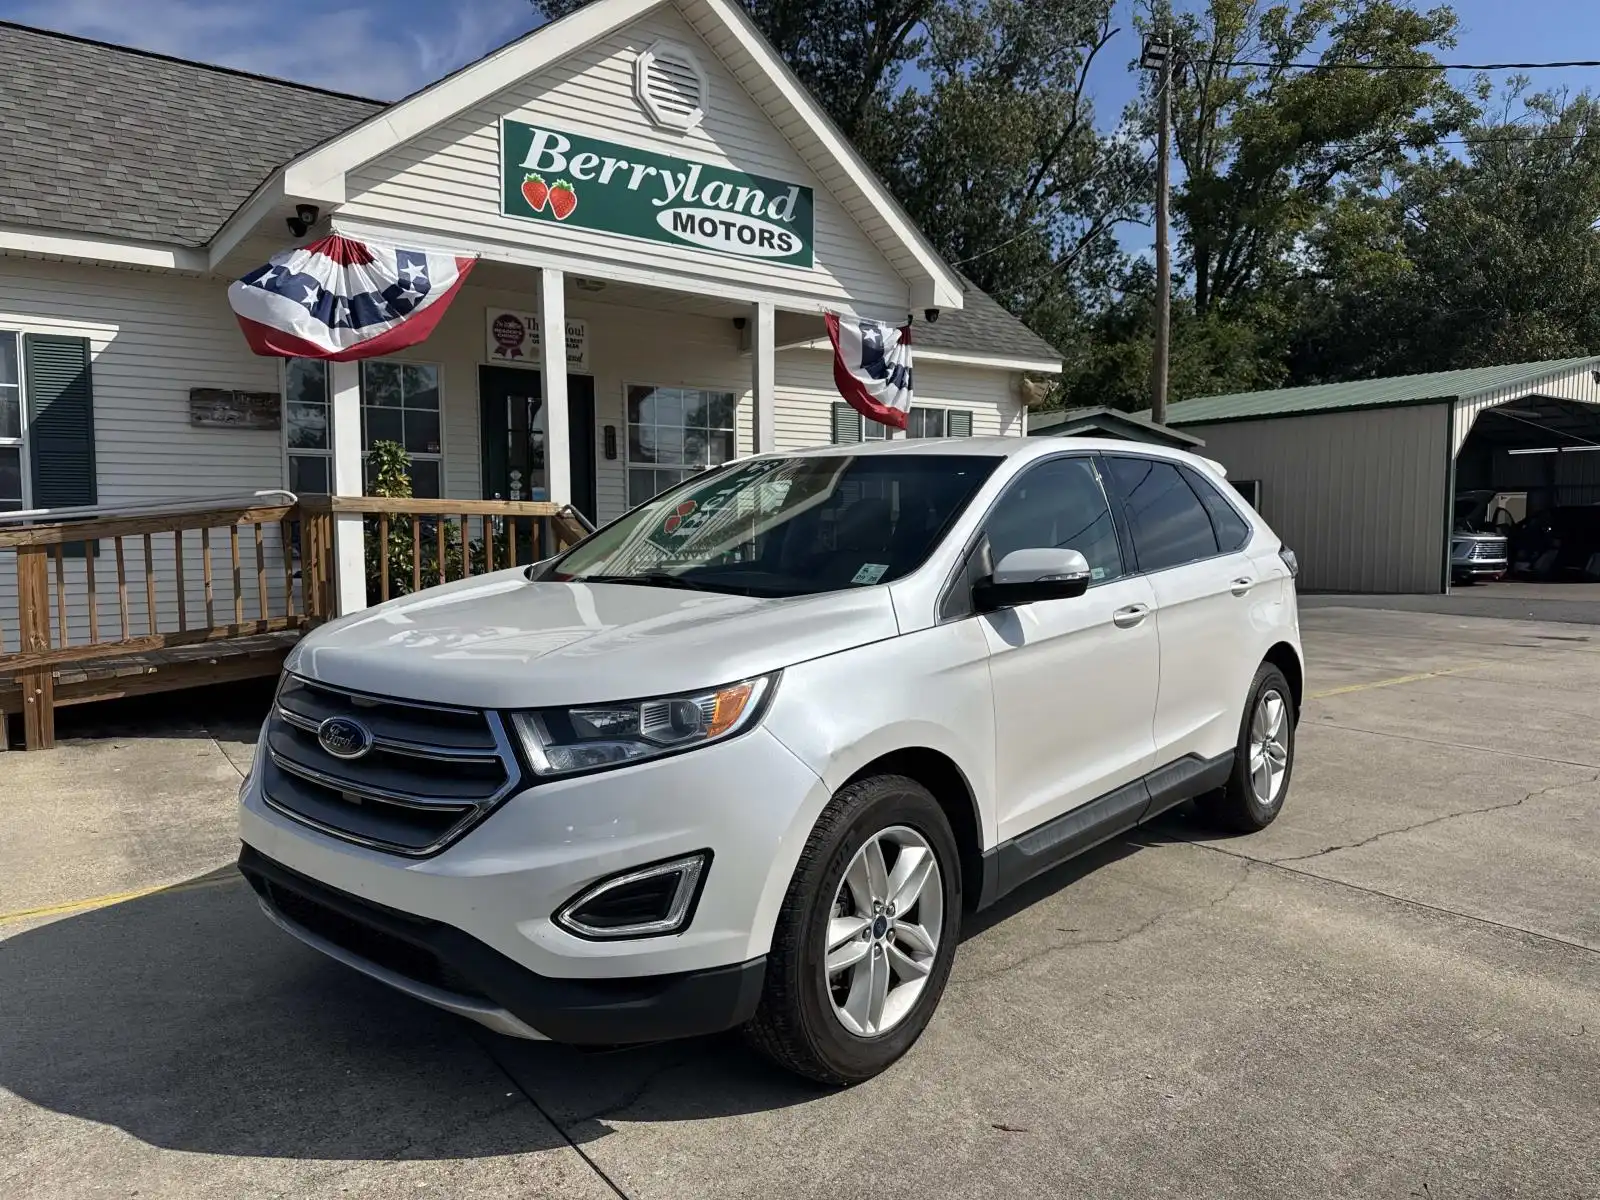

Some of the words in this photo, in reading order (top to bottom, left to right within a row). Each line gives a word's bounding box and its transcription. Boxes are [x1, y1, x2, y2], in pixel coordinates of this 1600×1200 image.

[518, 127, 800, 223] Berryland
[672, 211, 793, 253] MOTORS
[325, 723, 356, 748] Ford
